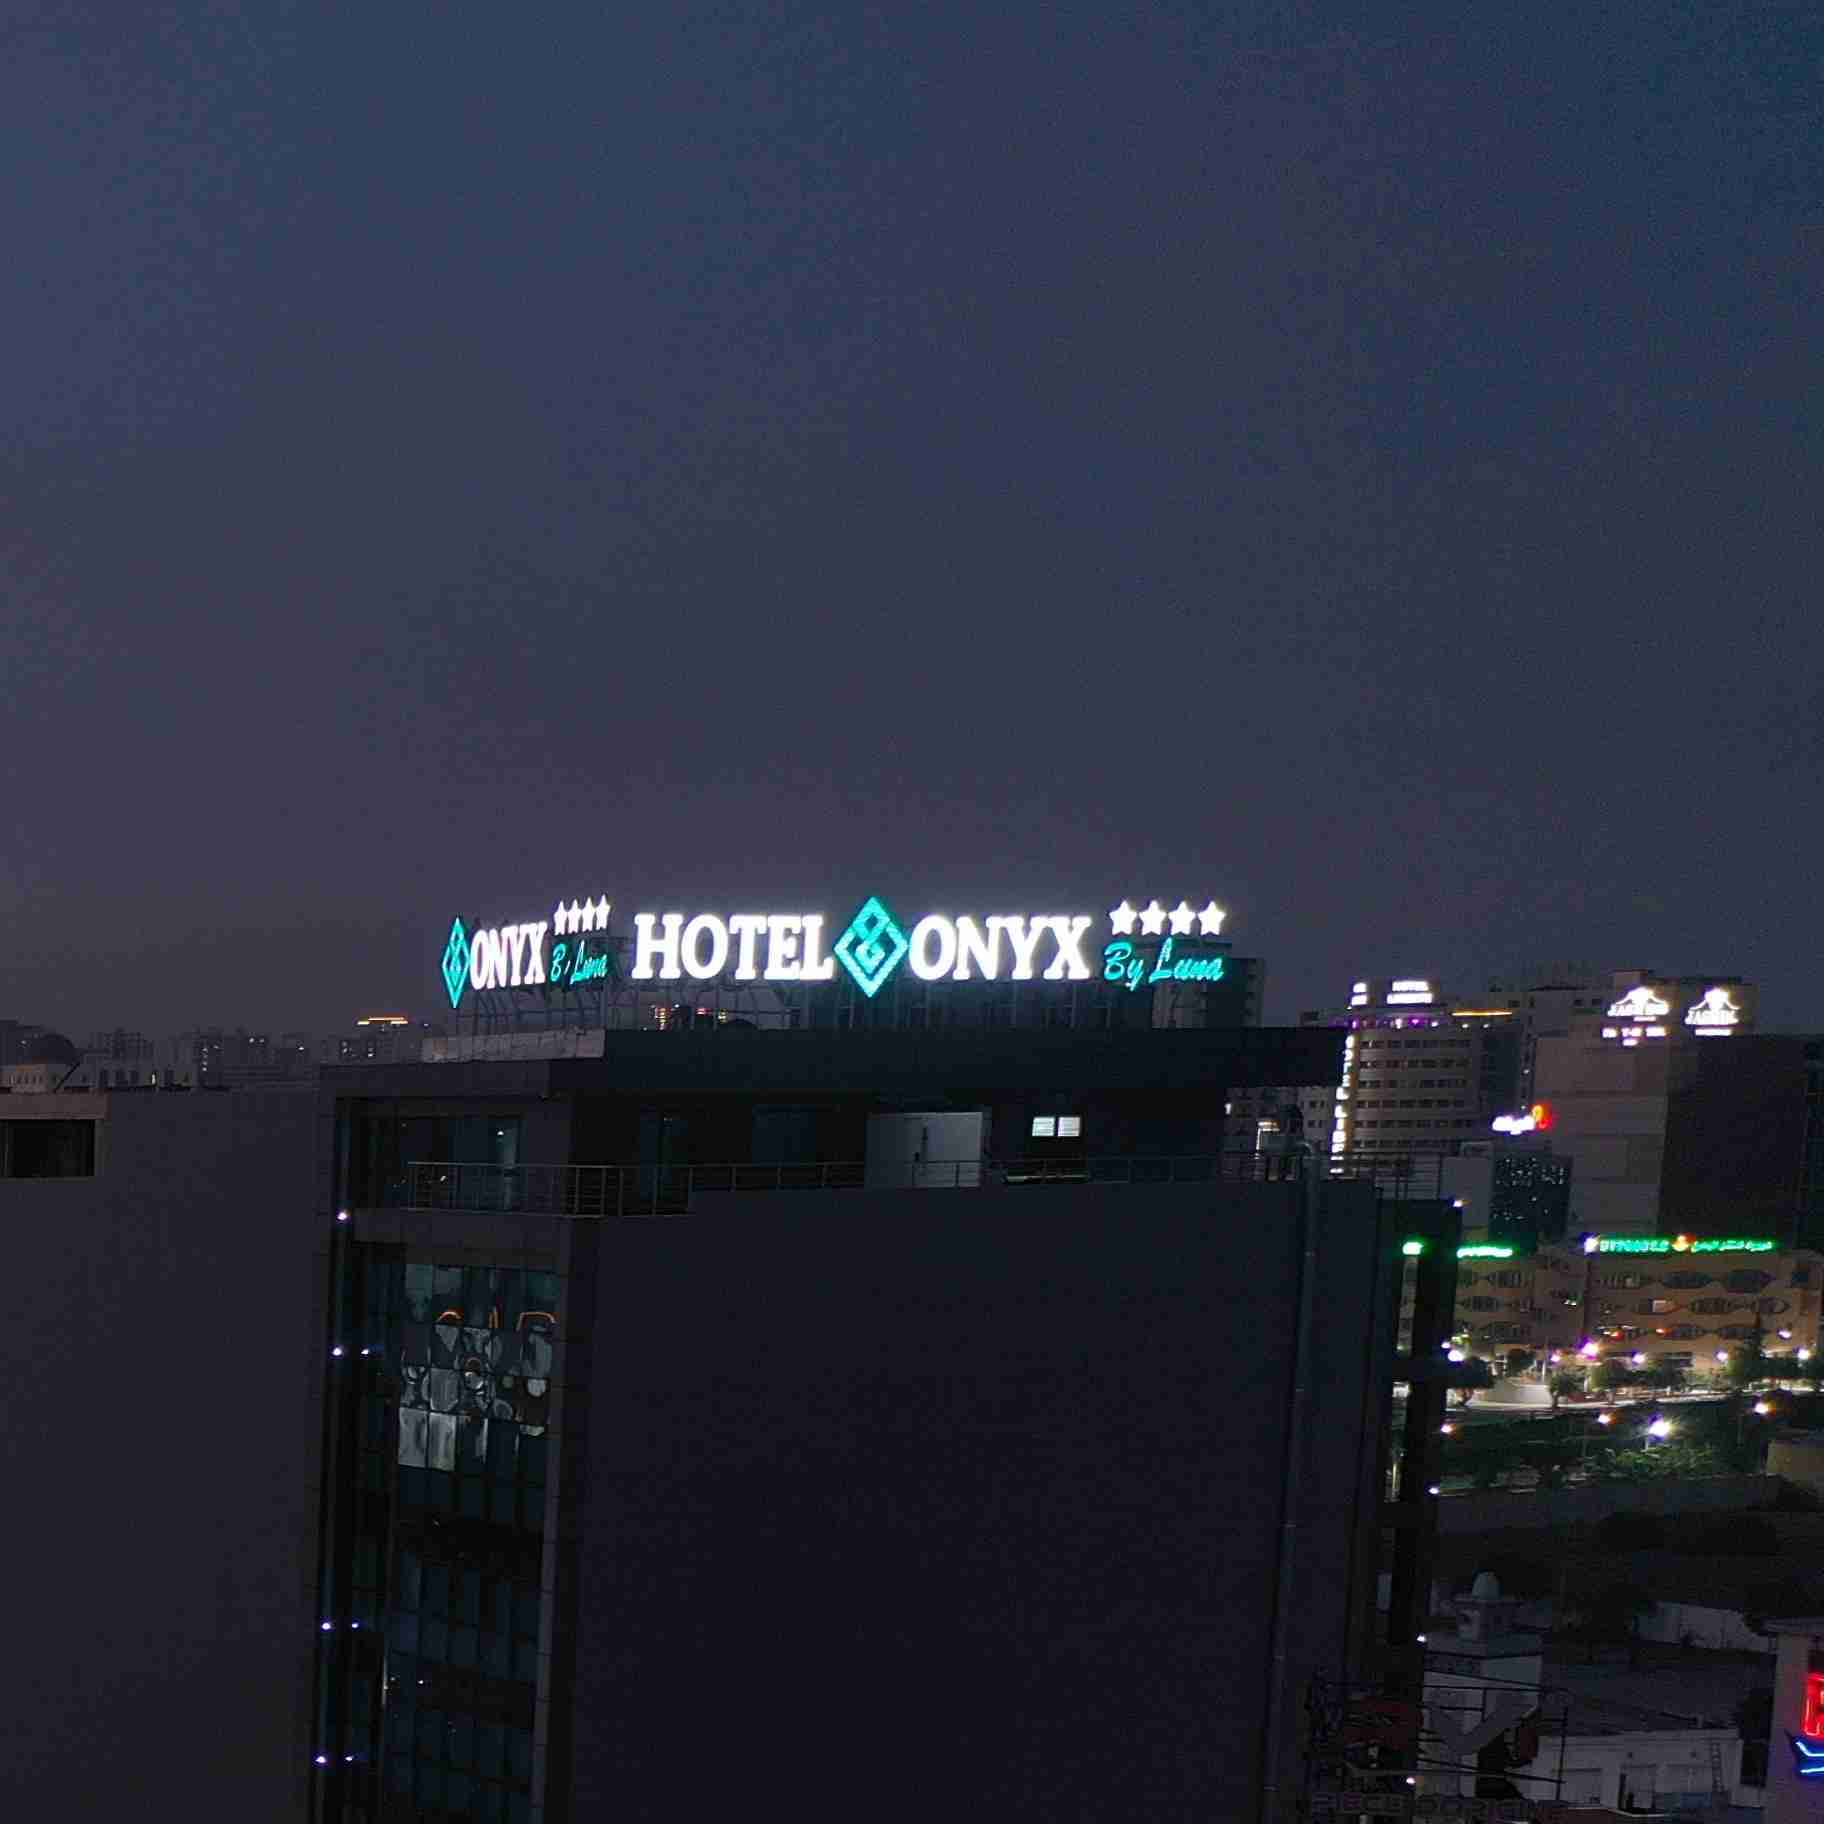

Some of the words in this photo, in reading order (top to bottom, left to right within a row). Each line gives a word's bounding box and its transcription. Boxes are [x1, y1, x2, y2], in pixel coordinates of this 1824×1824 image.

[471, 922, 547, 990] ONYX
[632, 914, 834, 979] HOTEL
[908, 915, 1091, 979] ONYX
[1104, 942, 1143, 991] By
[1149, 937, 1225, 984] Luna
